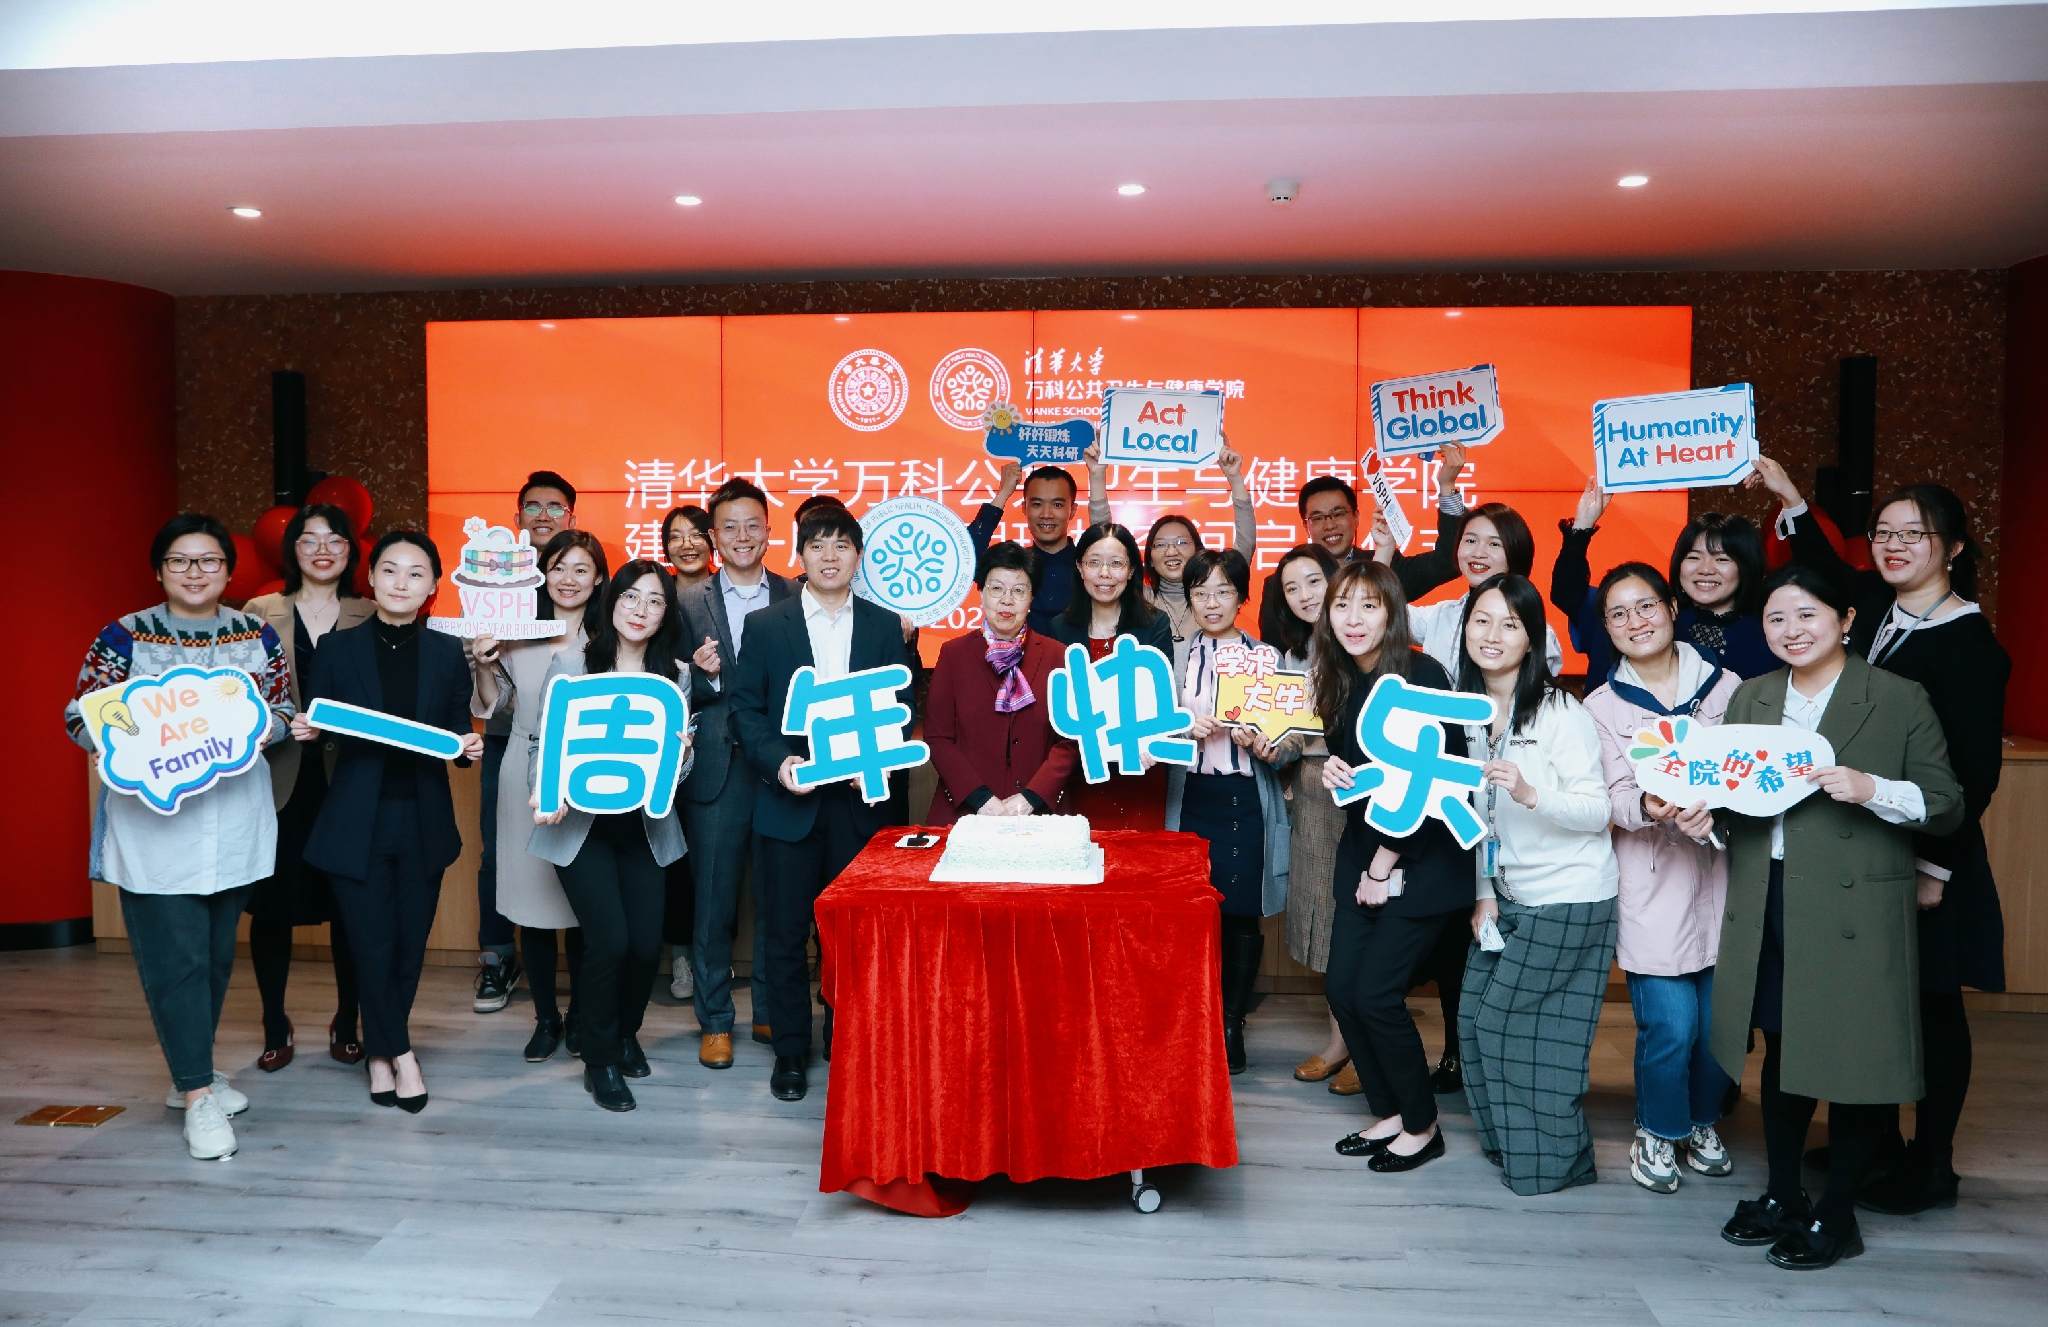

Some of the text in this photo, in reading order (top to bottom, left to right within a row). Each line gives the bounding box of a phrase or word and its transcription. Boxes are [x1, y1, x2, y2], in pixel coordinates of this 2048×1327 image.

[1025, 406, 1103, 416] VANKE SCHOO
[1391, 381, 1476, 413] Think
[1138, 401, 1188, 426] Act
[1387, 404, 1488, 440] Global
[1608, 411, 1745, 443] Humanity
[1026, 444, 1079, 461] 天天科研
[1122, 427, 1199, 454] Local
[1618, 439, 1736, 469] At Heart
[1372, 471, 1392, 509] VSPH
[462, 591, 534, 619] VSPH
[430, 621, 462, 633] HAPPY
[514, 623, 564, 637] BIRTHDAY!
[1214, 646, 1277, 680] 学术
[141, 688, 199, 719] We
[1050, 637, 1195, 782] 快
[1243, 681, 1304, 716] 大牛
[160, 717, 209, 747] Are
[538, 674, 688, 817] 周
[783, 668, 929, 801] 年
[149, 737, 233, 779] Family
[1336, 675, 1495, 846] 乐
[1653, 749, 1816, 794] 全院的希望
